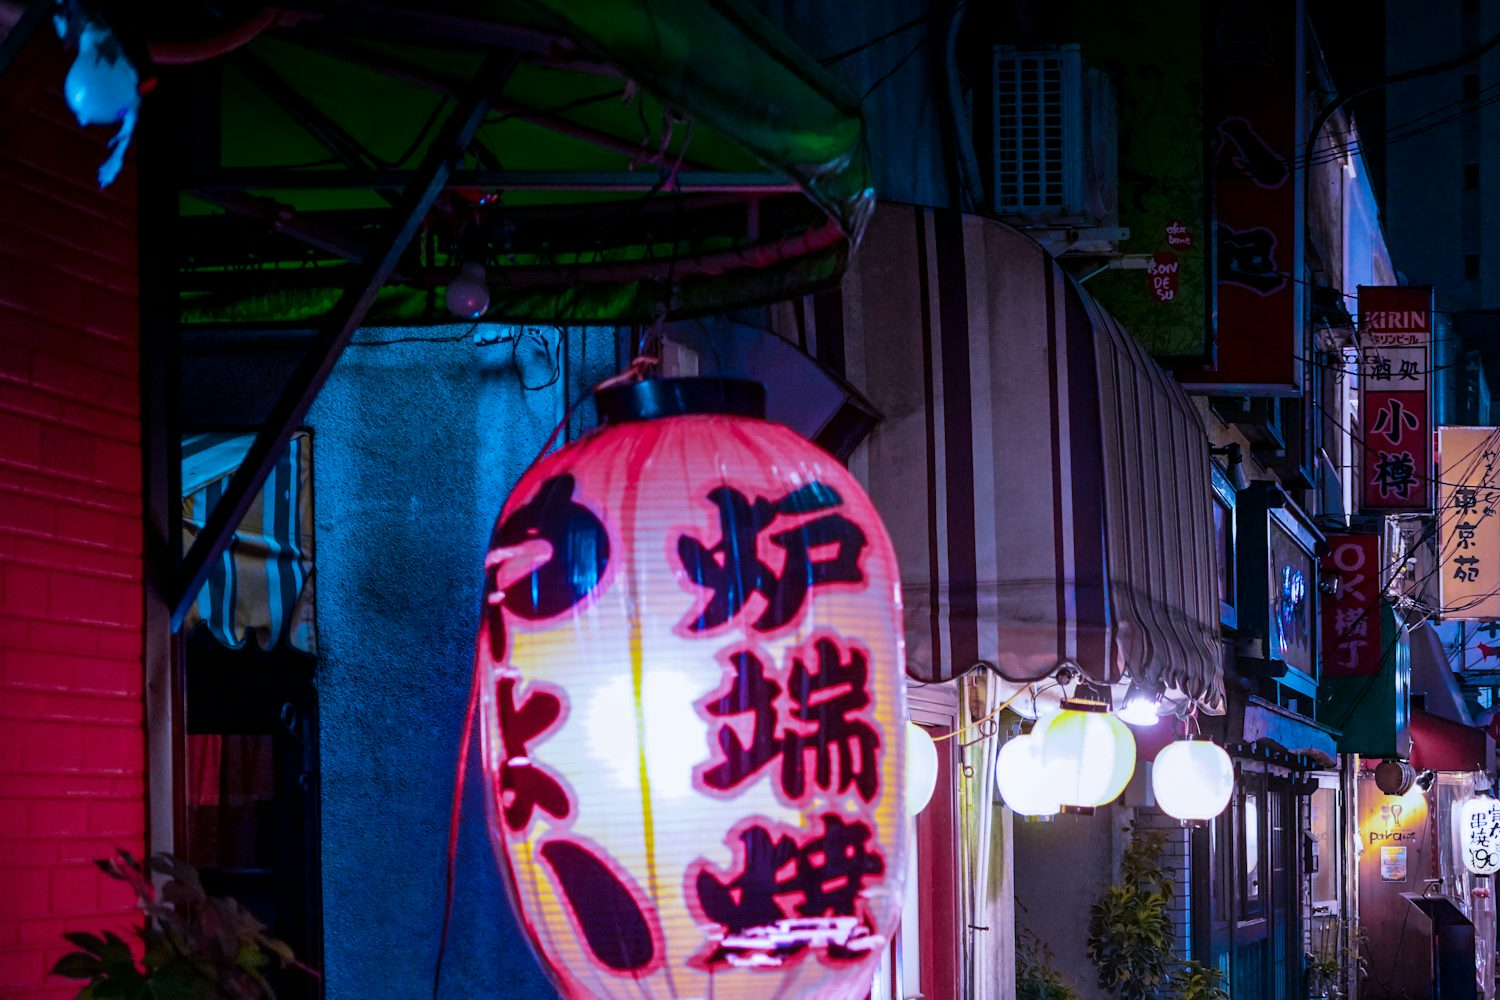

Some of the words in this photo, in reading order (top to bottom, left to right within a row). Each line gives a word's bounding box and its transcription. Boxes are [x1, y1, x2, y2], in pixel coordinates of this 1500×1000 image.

[1153, 276, 1170, 289] DE
[1370, 359, 1419, 381] 酒処
[1372, 334, 1418, 345] キリンビール
[1371, 399, 1419, 499] 小樽
[1454, 487, 1480, 583] 東京苑
[1334, 543, 1368, 669] OK横丁
[677, 478, 883, 965] 炉端焼
